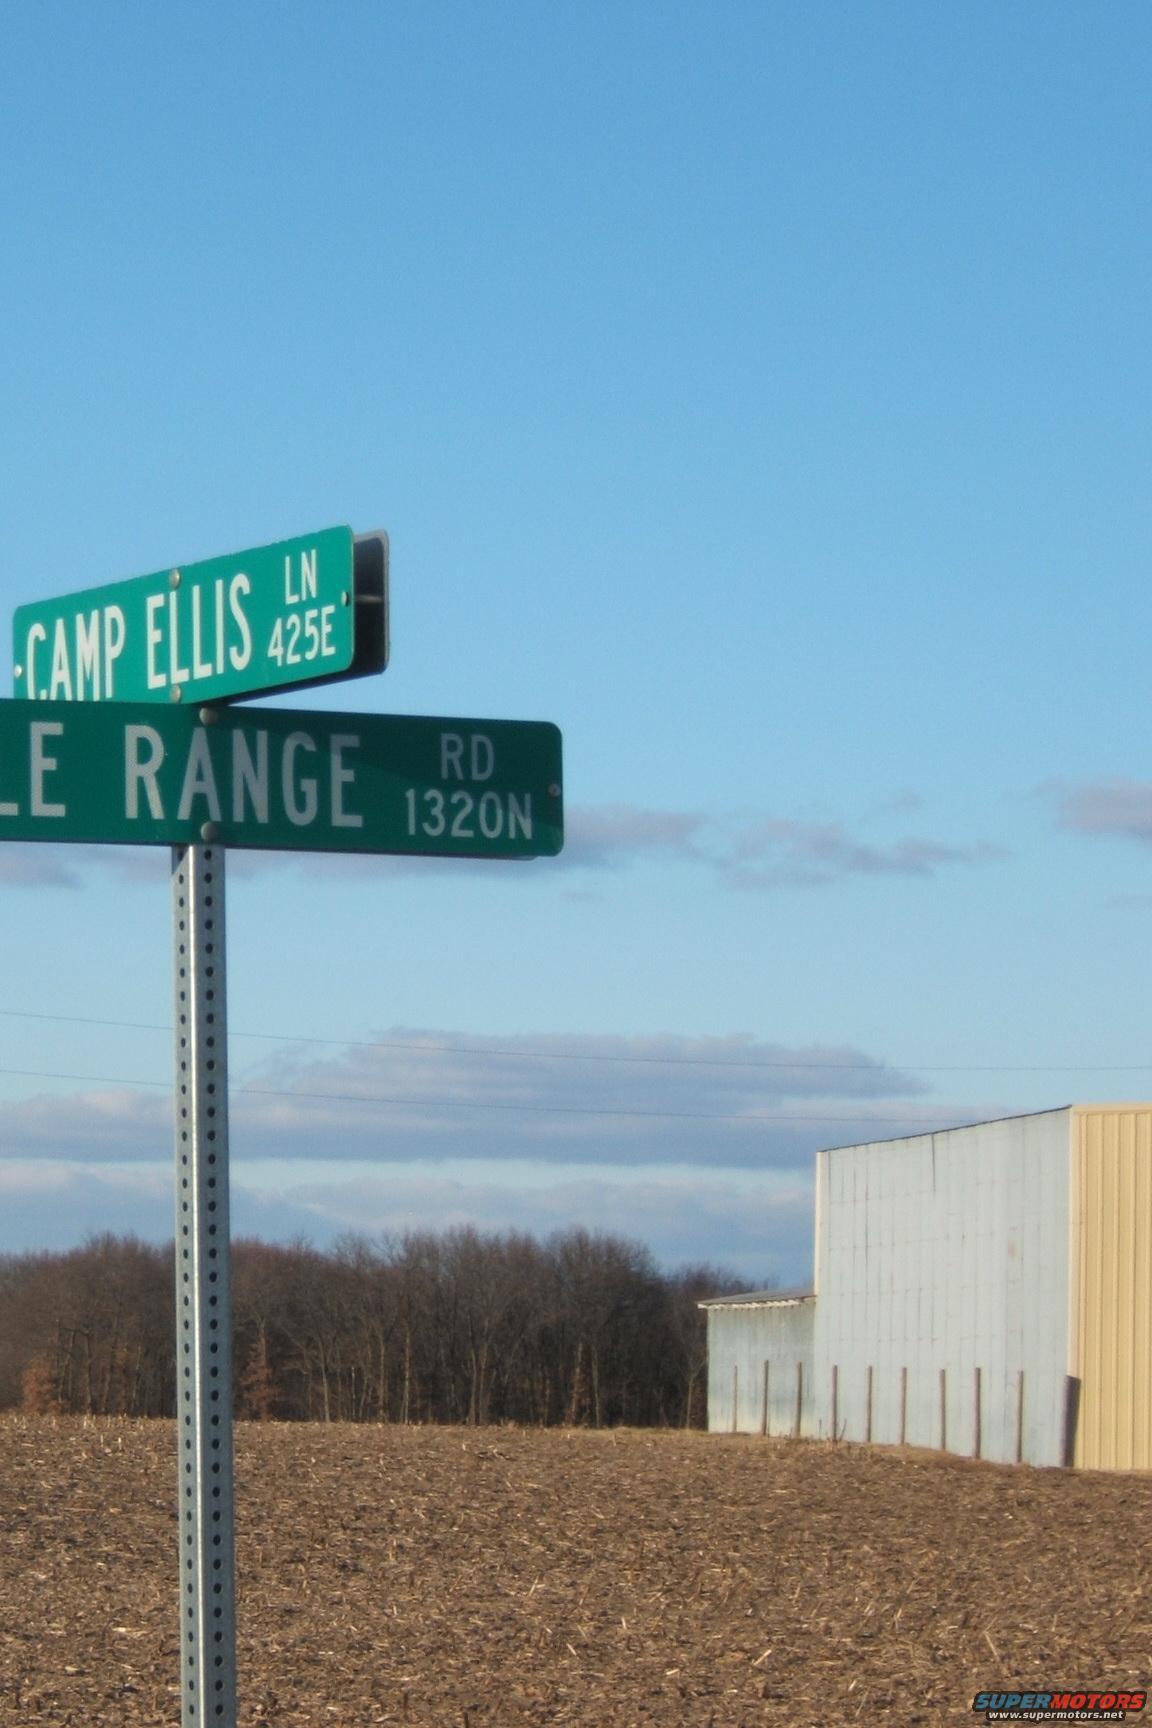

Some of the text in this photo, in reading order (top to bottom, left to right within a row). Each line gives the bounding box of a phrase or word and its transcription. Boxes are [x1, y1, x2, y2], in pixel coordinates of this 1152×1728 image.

[284, 549, 317, 606] LN
[26, 572, 252, 701] CAMP ELLIS
[267, 605, 336, 667] 425E
[124, 724, 364, 828] RANGE
[440, 732, 495, 782] RD
[405, 788, 534, 840] 1320N
